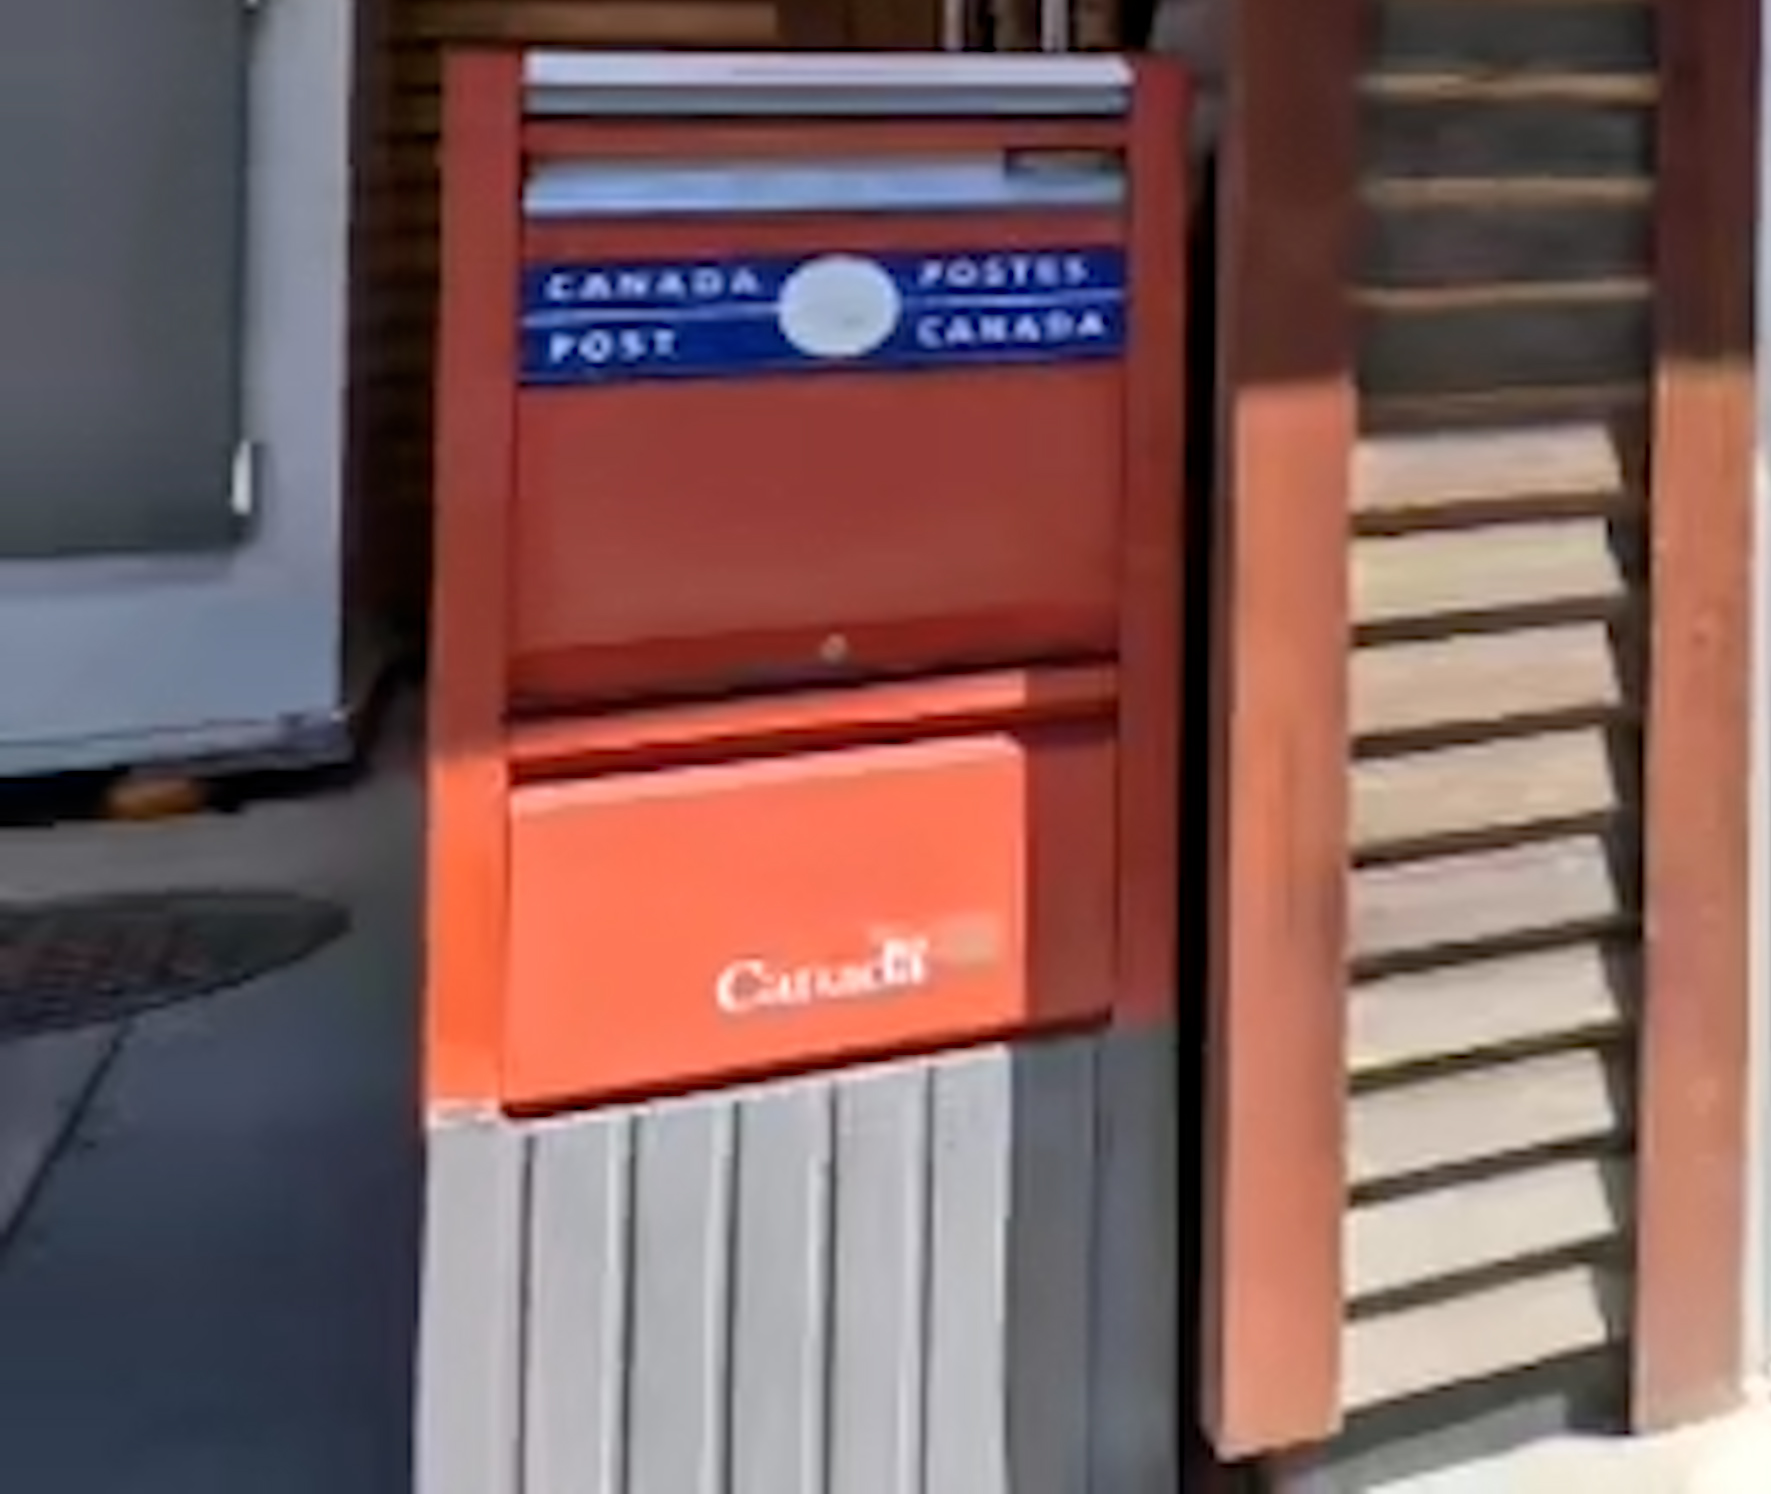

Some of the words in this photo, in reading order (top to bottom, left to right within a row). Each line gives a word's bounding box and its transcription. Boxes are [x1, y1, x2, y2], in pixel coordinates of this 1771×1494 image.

[546, 265, 763, 304] CANADA
[919, 257, 1089, 290] POSTES
[549, 328, 678, 365] POST
[917, 310, 1106, 349] CANADA
[714, 936, 930, 1014] Canada
